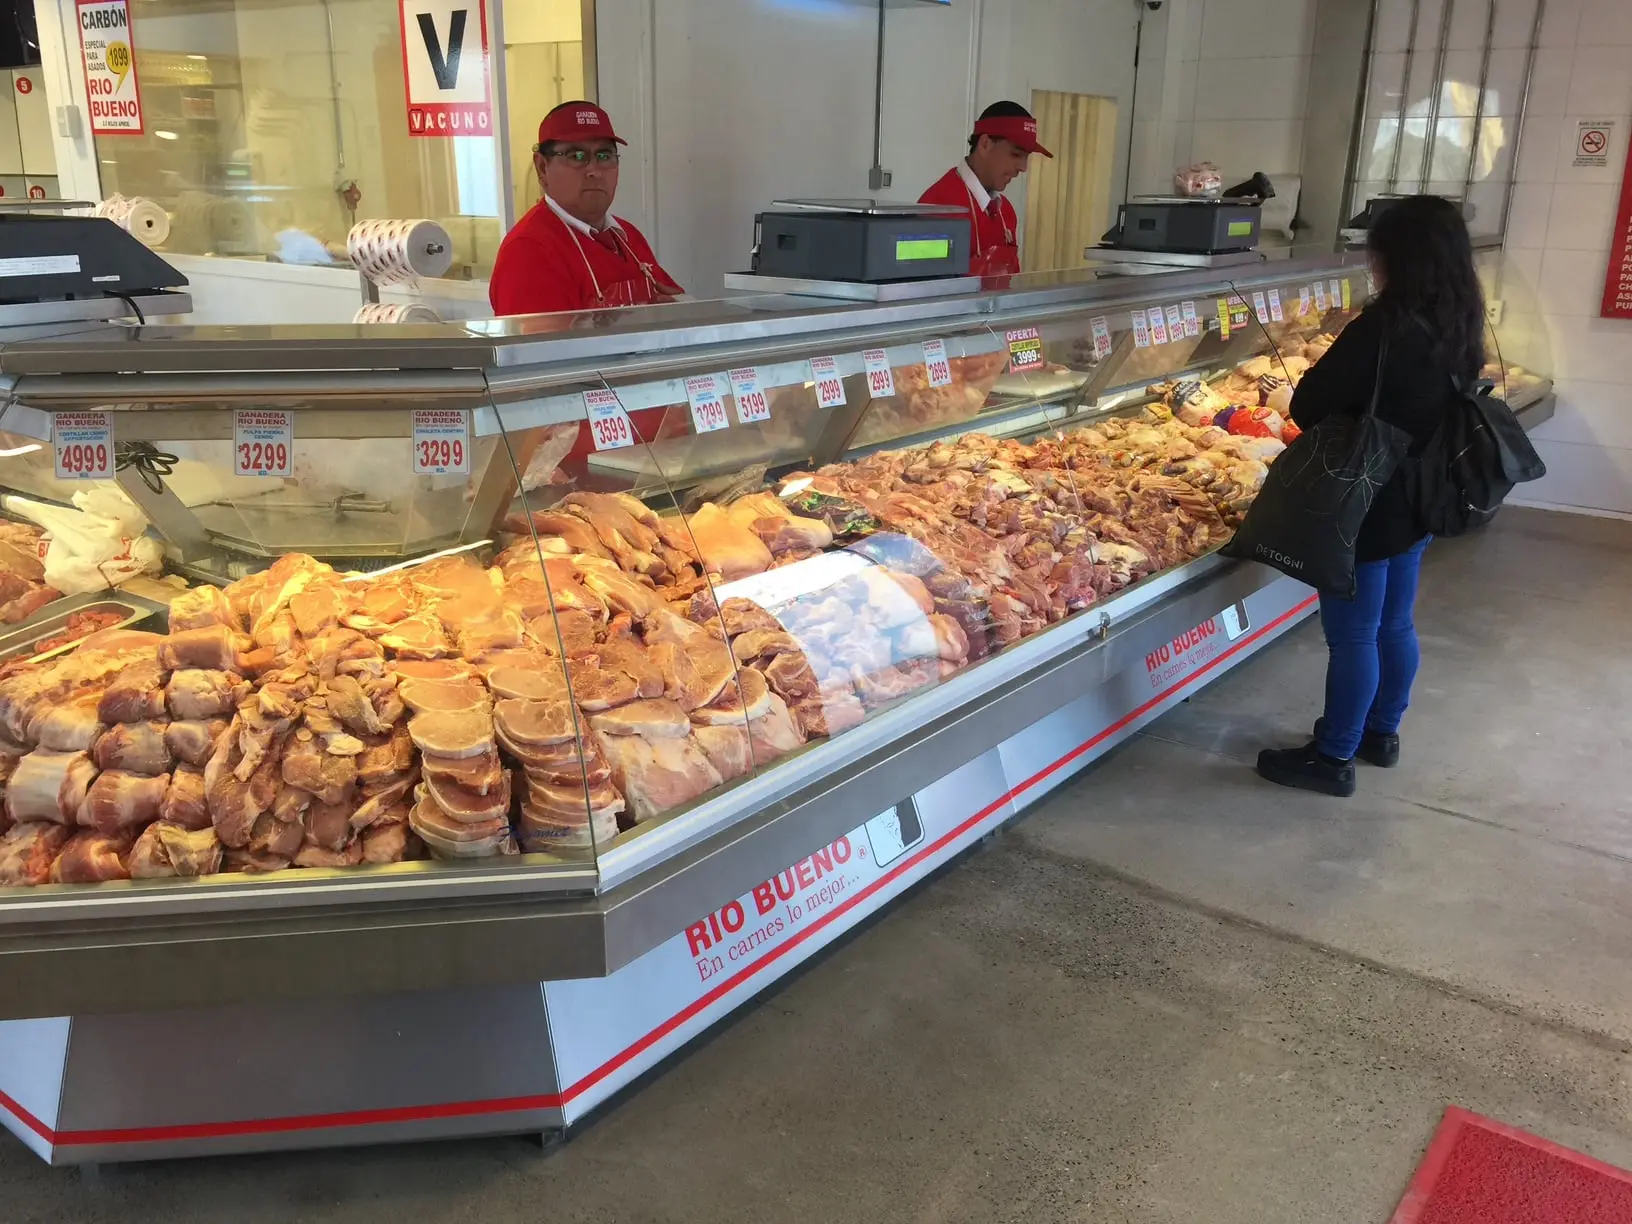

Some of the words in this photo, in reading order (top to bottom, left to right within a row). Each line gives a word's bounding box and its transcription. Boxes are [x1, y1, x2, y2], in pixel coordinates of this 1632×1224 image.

[81, 5, 126, 30] CARBÓN
[85, 40, 106, 49] ESPECIAL
[416, 10, 467, 90] V
[87, 51, 98, 60] PARA
[110, 47, 129, 66] 1899
[90, 78, 112, 95] RIO
[93, 100, 137, 117] BUENO
[411, 111, 488, 130] VACUNO
[1006, 327, 1038, 341] OFERTA
[1016, 349, 1037, 365] 3999
[1145, 644, 1170, 673] RIO
[1172, 617, 1216, 656] BUENO
[684, 899, 745, 958] RIO
[752, 835, 852, 917] BUENO
[695, 953, 724, 982] En
[728, 916, 785, 961] carnes
[786, 904, 803, 925] lo
